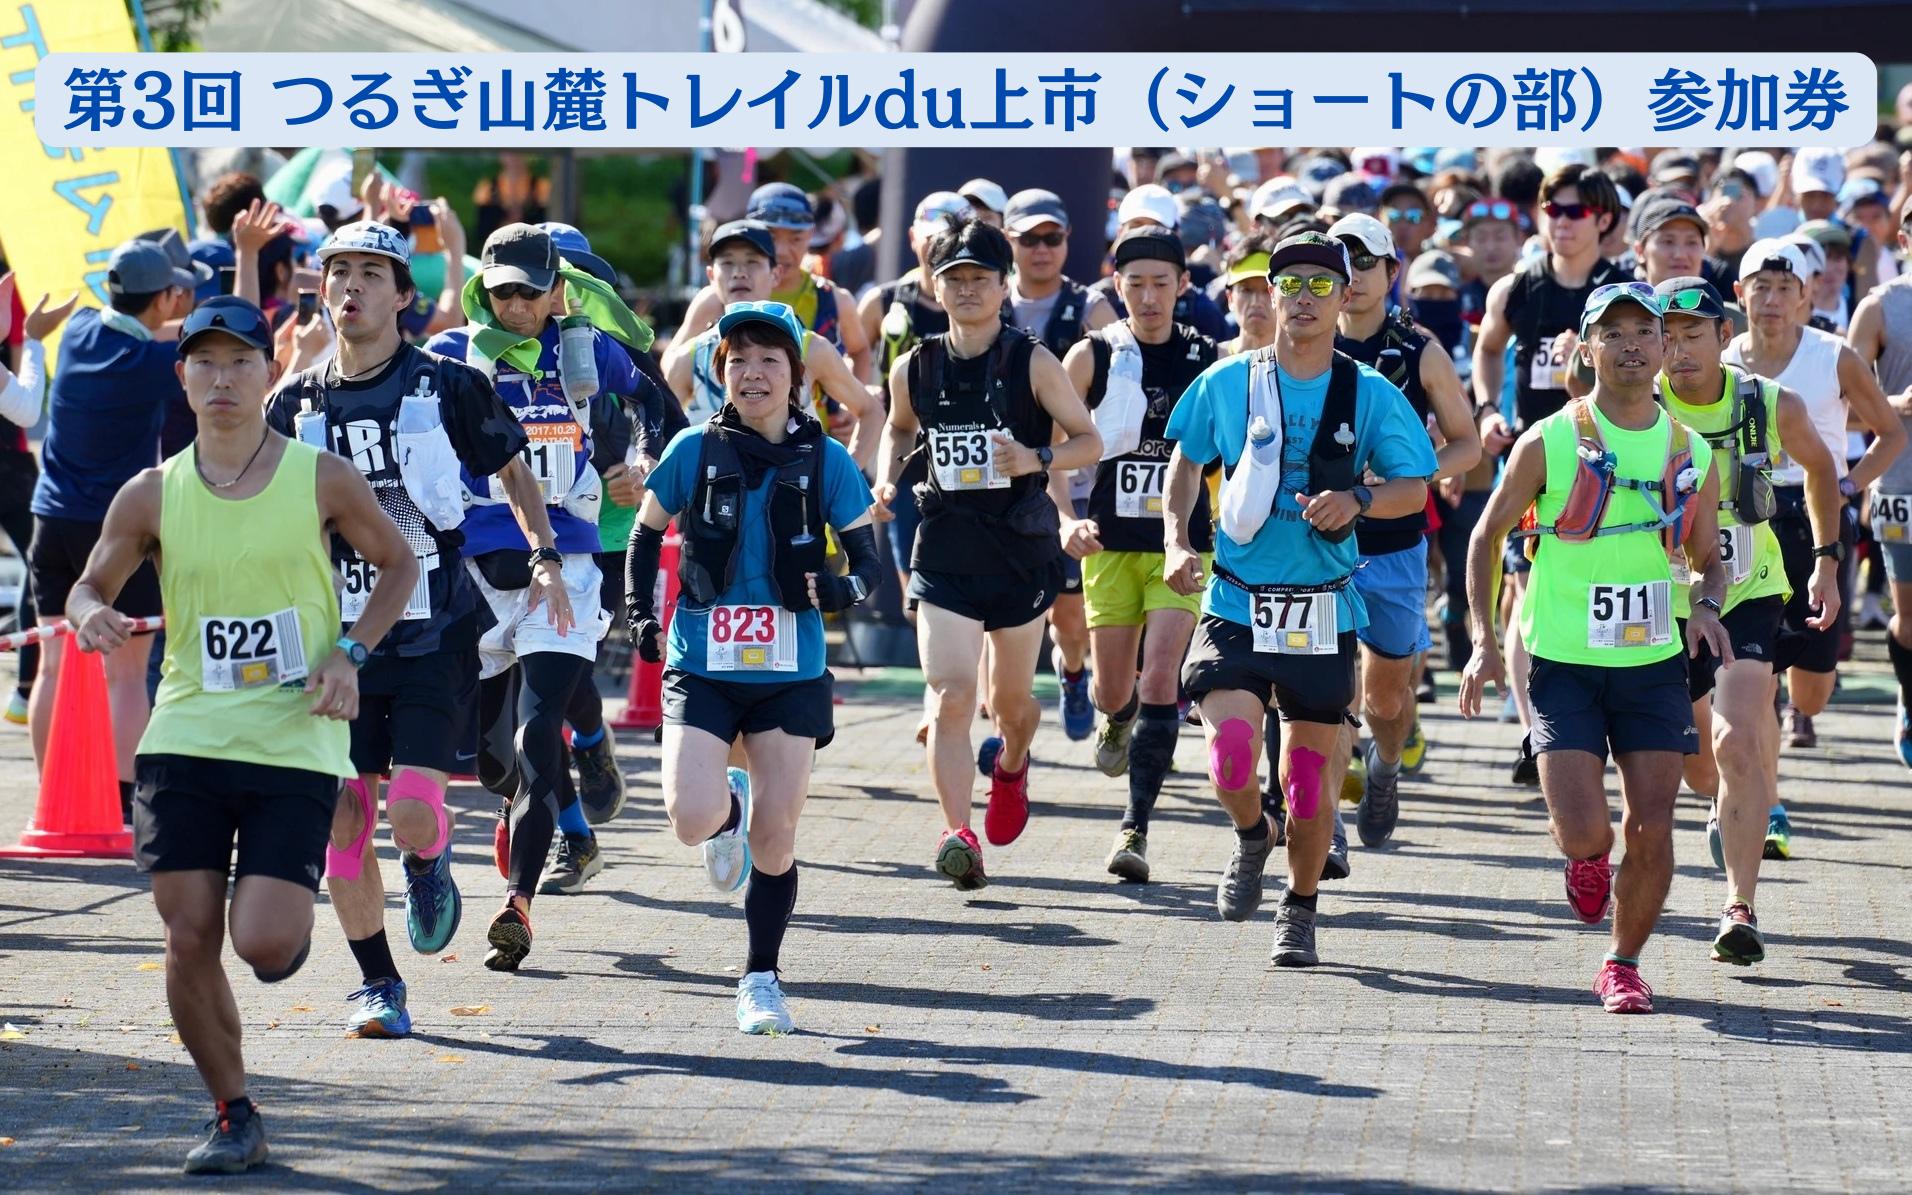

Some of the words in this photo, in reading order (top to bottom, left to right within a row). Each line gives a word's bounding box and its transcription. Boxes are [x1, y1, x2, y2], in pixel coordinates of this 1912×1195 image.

[525, 424, 577, 436] 2017.10.29
[935, 434, 988, 467] 553
[1254, 596, 1313, 630] 577
[1592, 585, 1649, 621] 511
[205, 619, 277, 661] 622
[711, 606, 776, 644] 823
